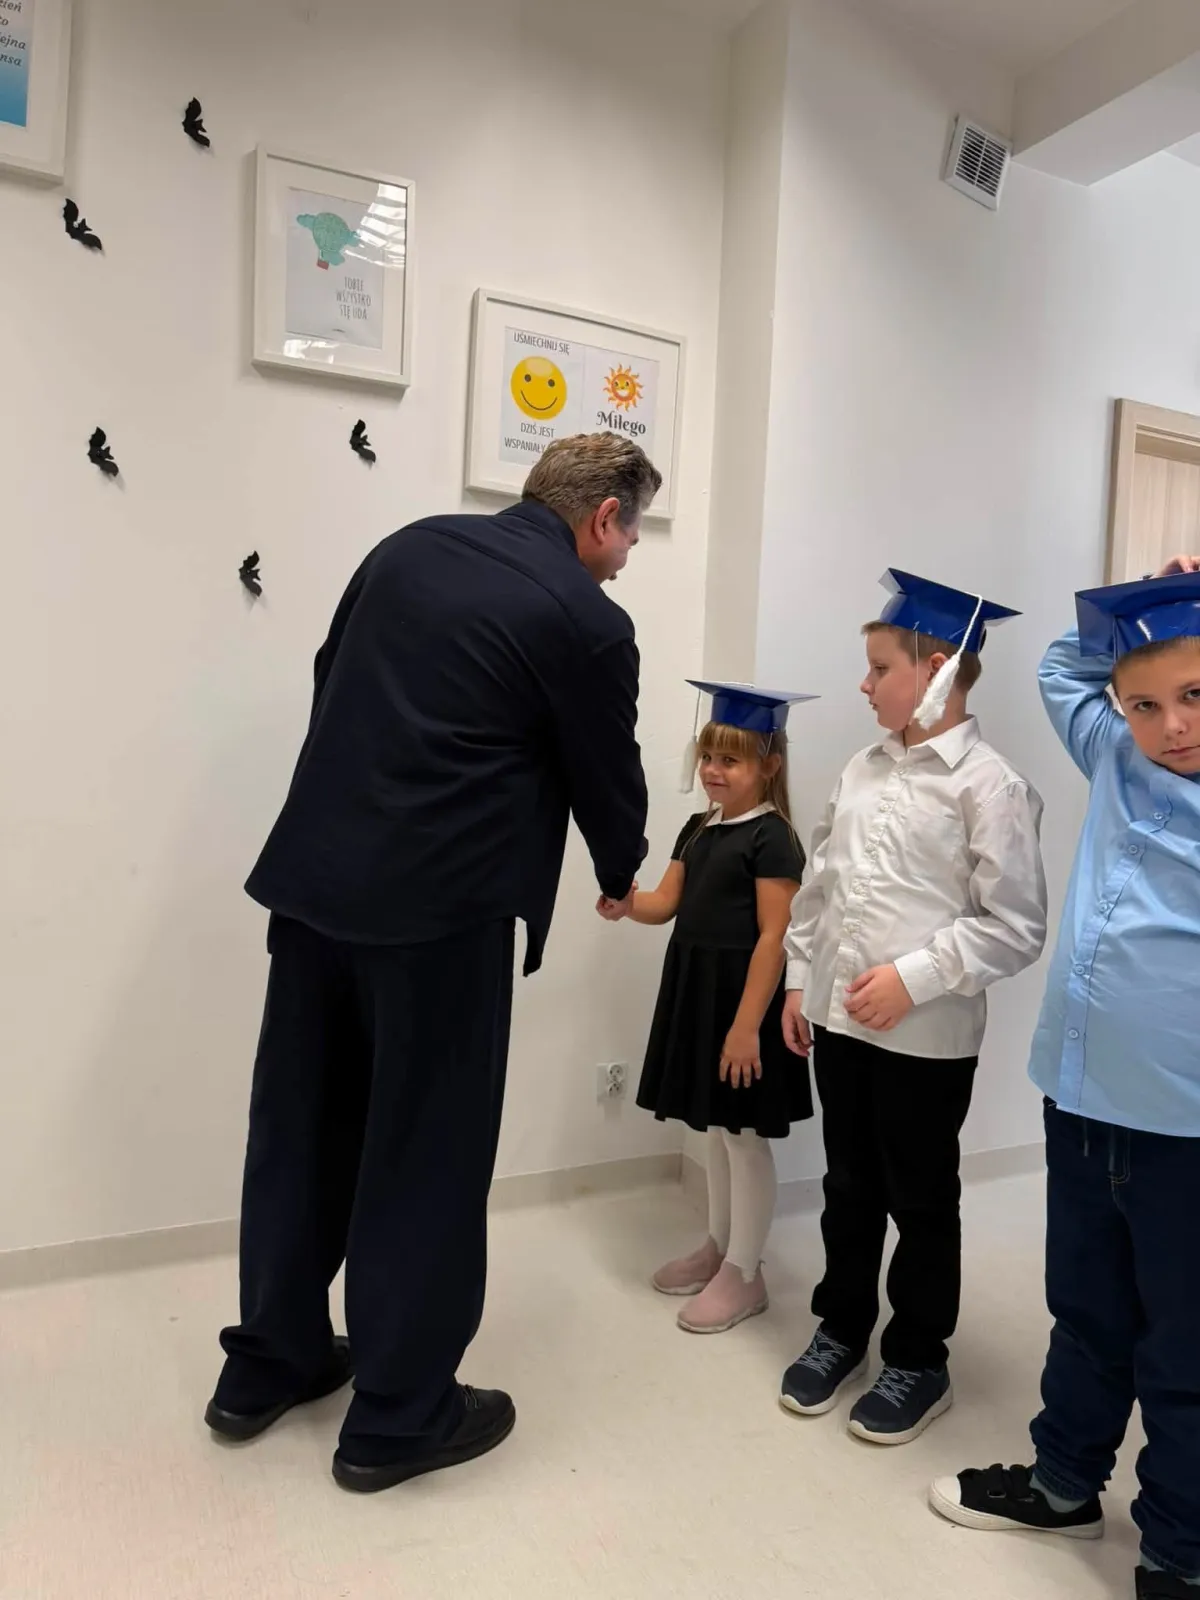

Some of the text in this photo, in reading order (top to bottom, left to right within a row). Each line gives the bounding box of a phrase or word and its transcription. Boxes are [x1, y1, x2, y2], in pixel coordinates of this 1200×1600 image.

[344, 276, 364, 292] TOBIE
[336, 288, 372, 307] WSZYSTKO
[340, 304, 367, 320] SIĘ UDA
[513, 331, 570, 356] UŚMIECHNIJ SIĘ
[520, 422, 556, 438] DZIŚ JEST
